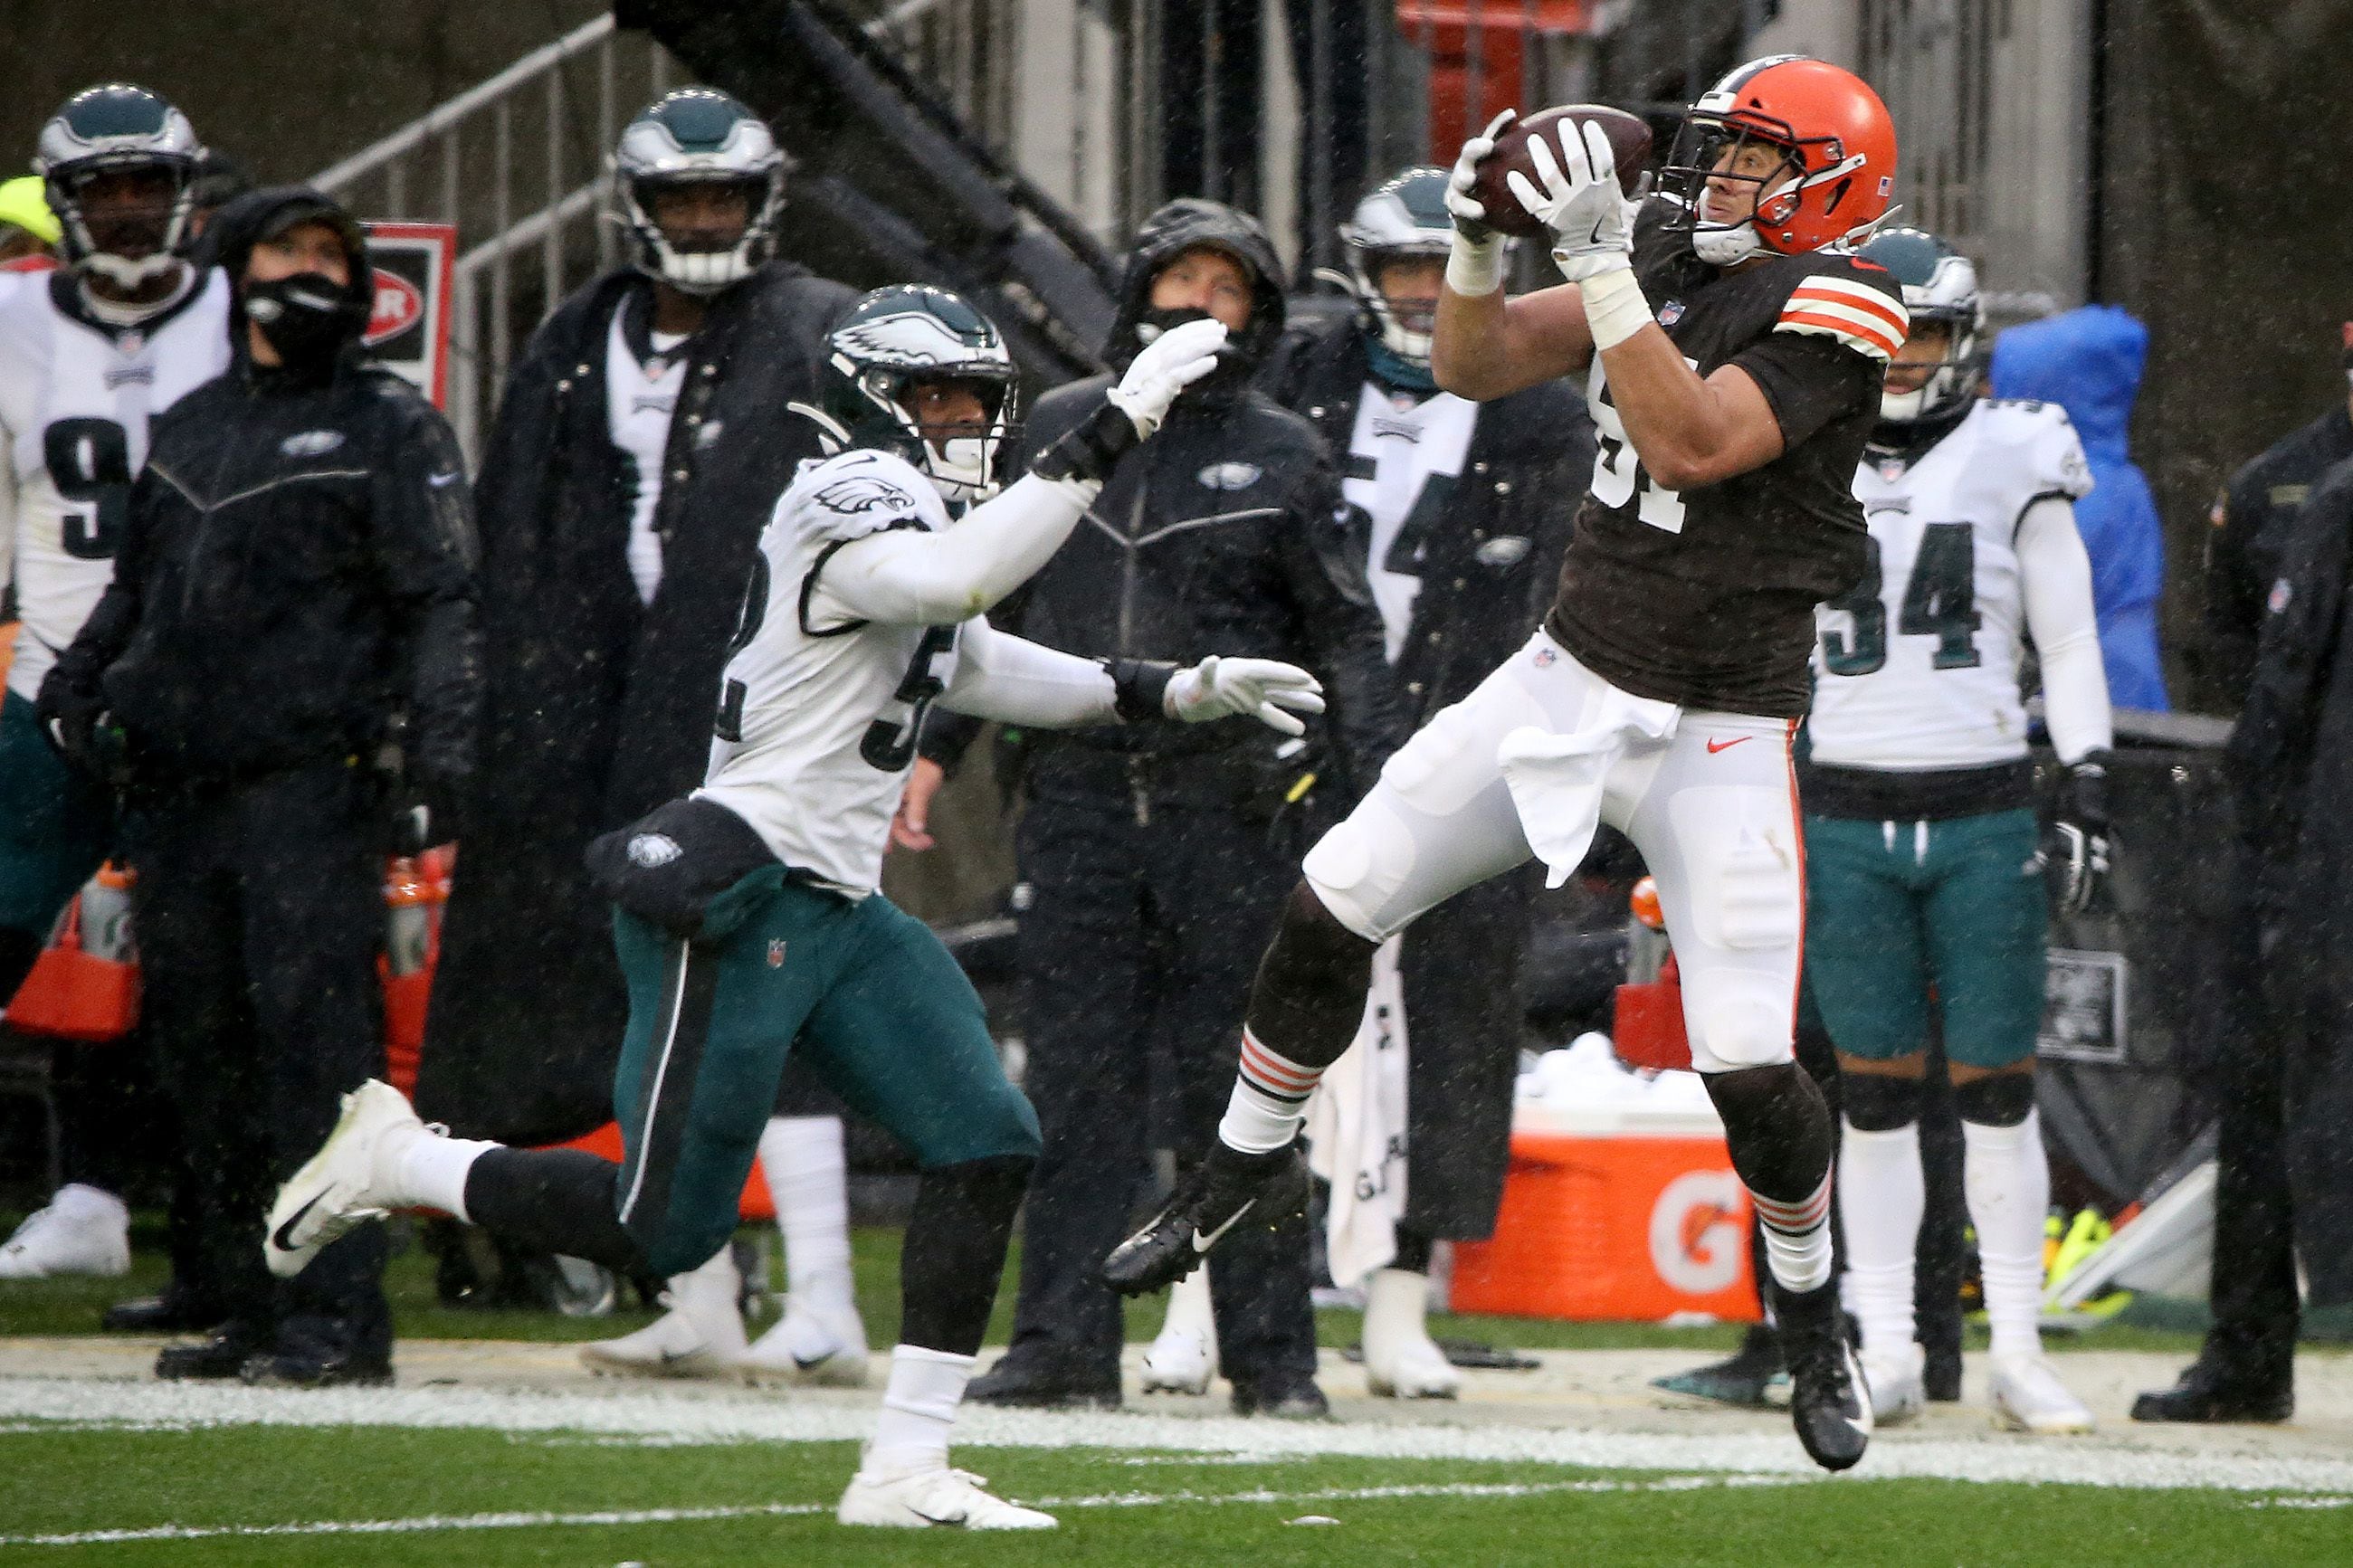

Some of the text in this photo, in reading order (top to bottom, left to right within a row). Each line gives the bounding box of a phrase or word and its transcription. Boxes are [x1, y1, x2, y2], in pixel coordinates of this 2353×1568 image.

[43, 416, 165, 558] 9
[1821, 521, 1983, 676] 34
[1650, 1168, 1742, 1294] G
